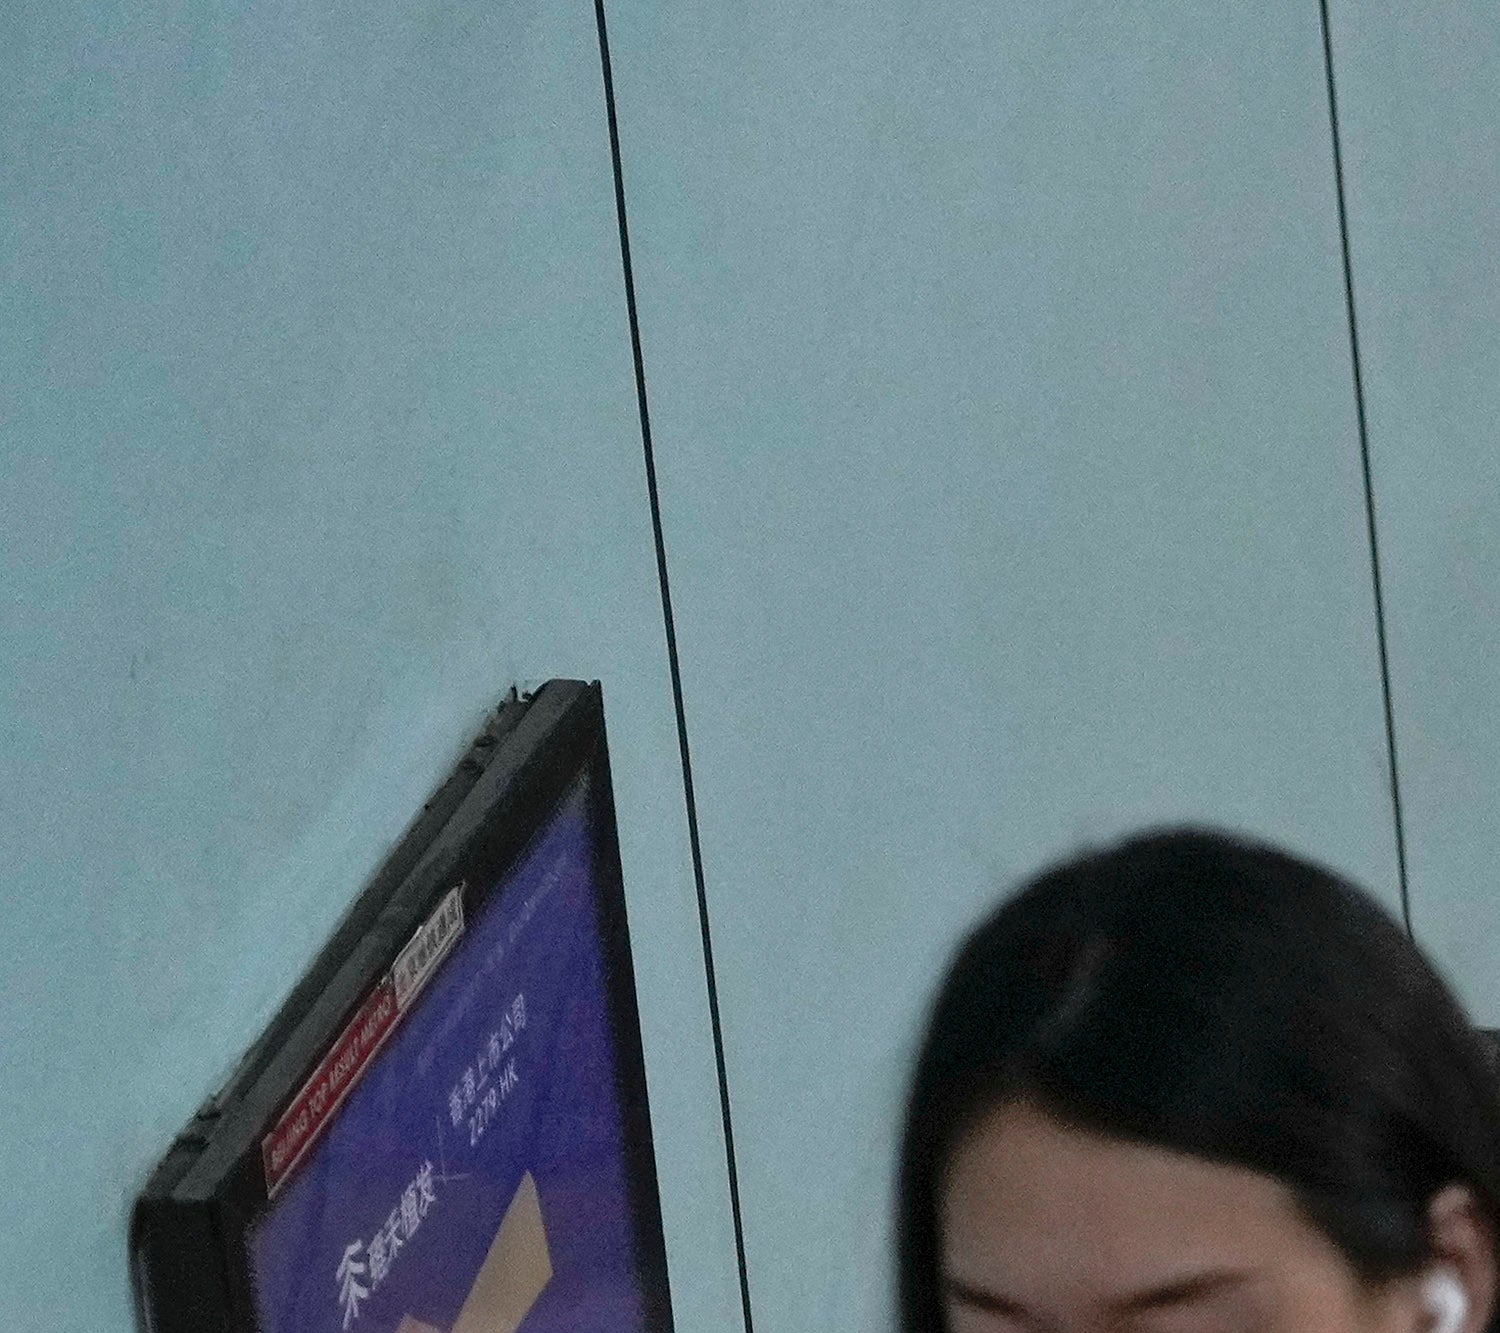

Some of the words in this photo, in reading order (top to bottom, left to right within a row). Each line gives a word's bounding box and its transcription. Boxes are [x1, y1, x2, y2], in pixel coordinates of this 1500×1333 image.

[449, 993, 526, 1126] 香港上市公司
[367, 1159, 435, 1291] 雍禾植发
